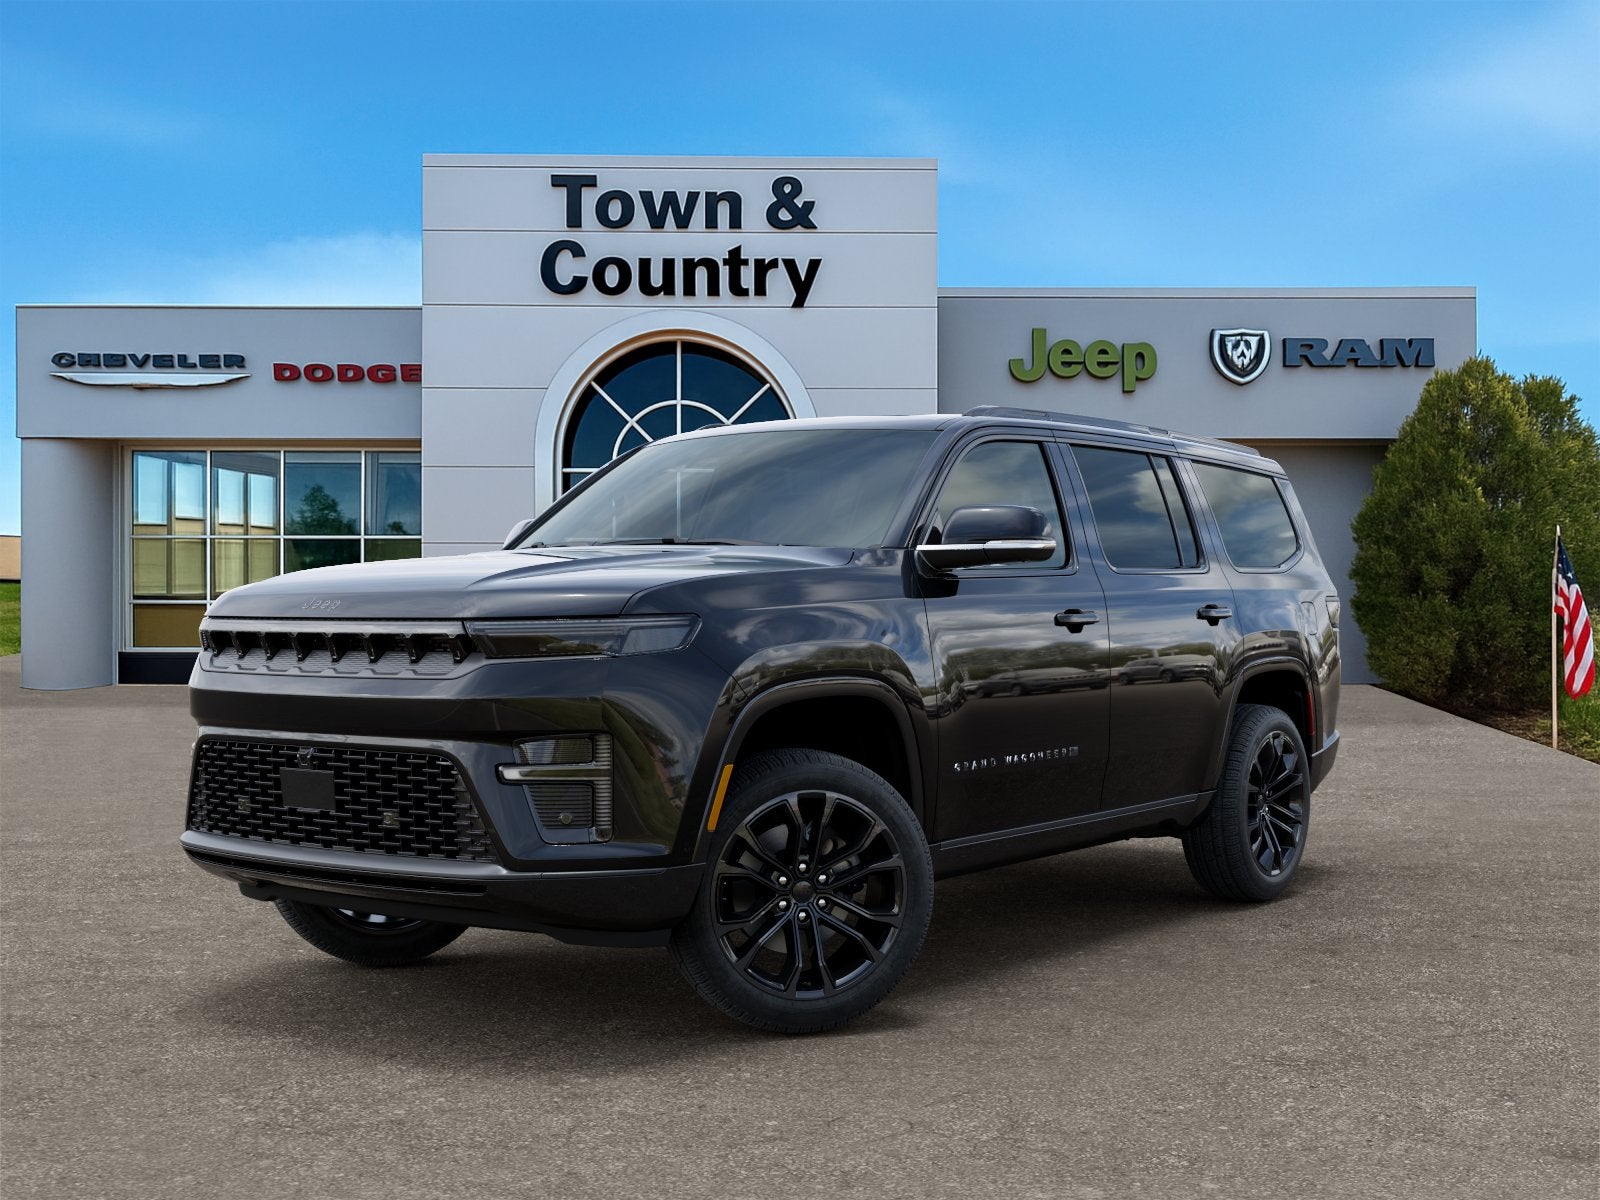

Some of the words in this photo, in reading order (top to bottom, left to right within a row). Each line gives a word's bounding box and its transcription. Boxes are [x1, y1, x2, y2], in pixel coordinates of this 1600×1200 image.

[550, 174, 742, 228] Town
[765, 175, 818, 229] &
[540, 239, 822, 308] Country
[273, 362, 422, 383] DODGE
[1009, 327, 1157, 392] Jeep
[1282, 337, 1436, 368] RAM
